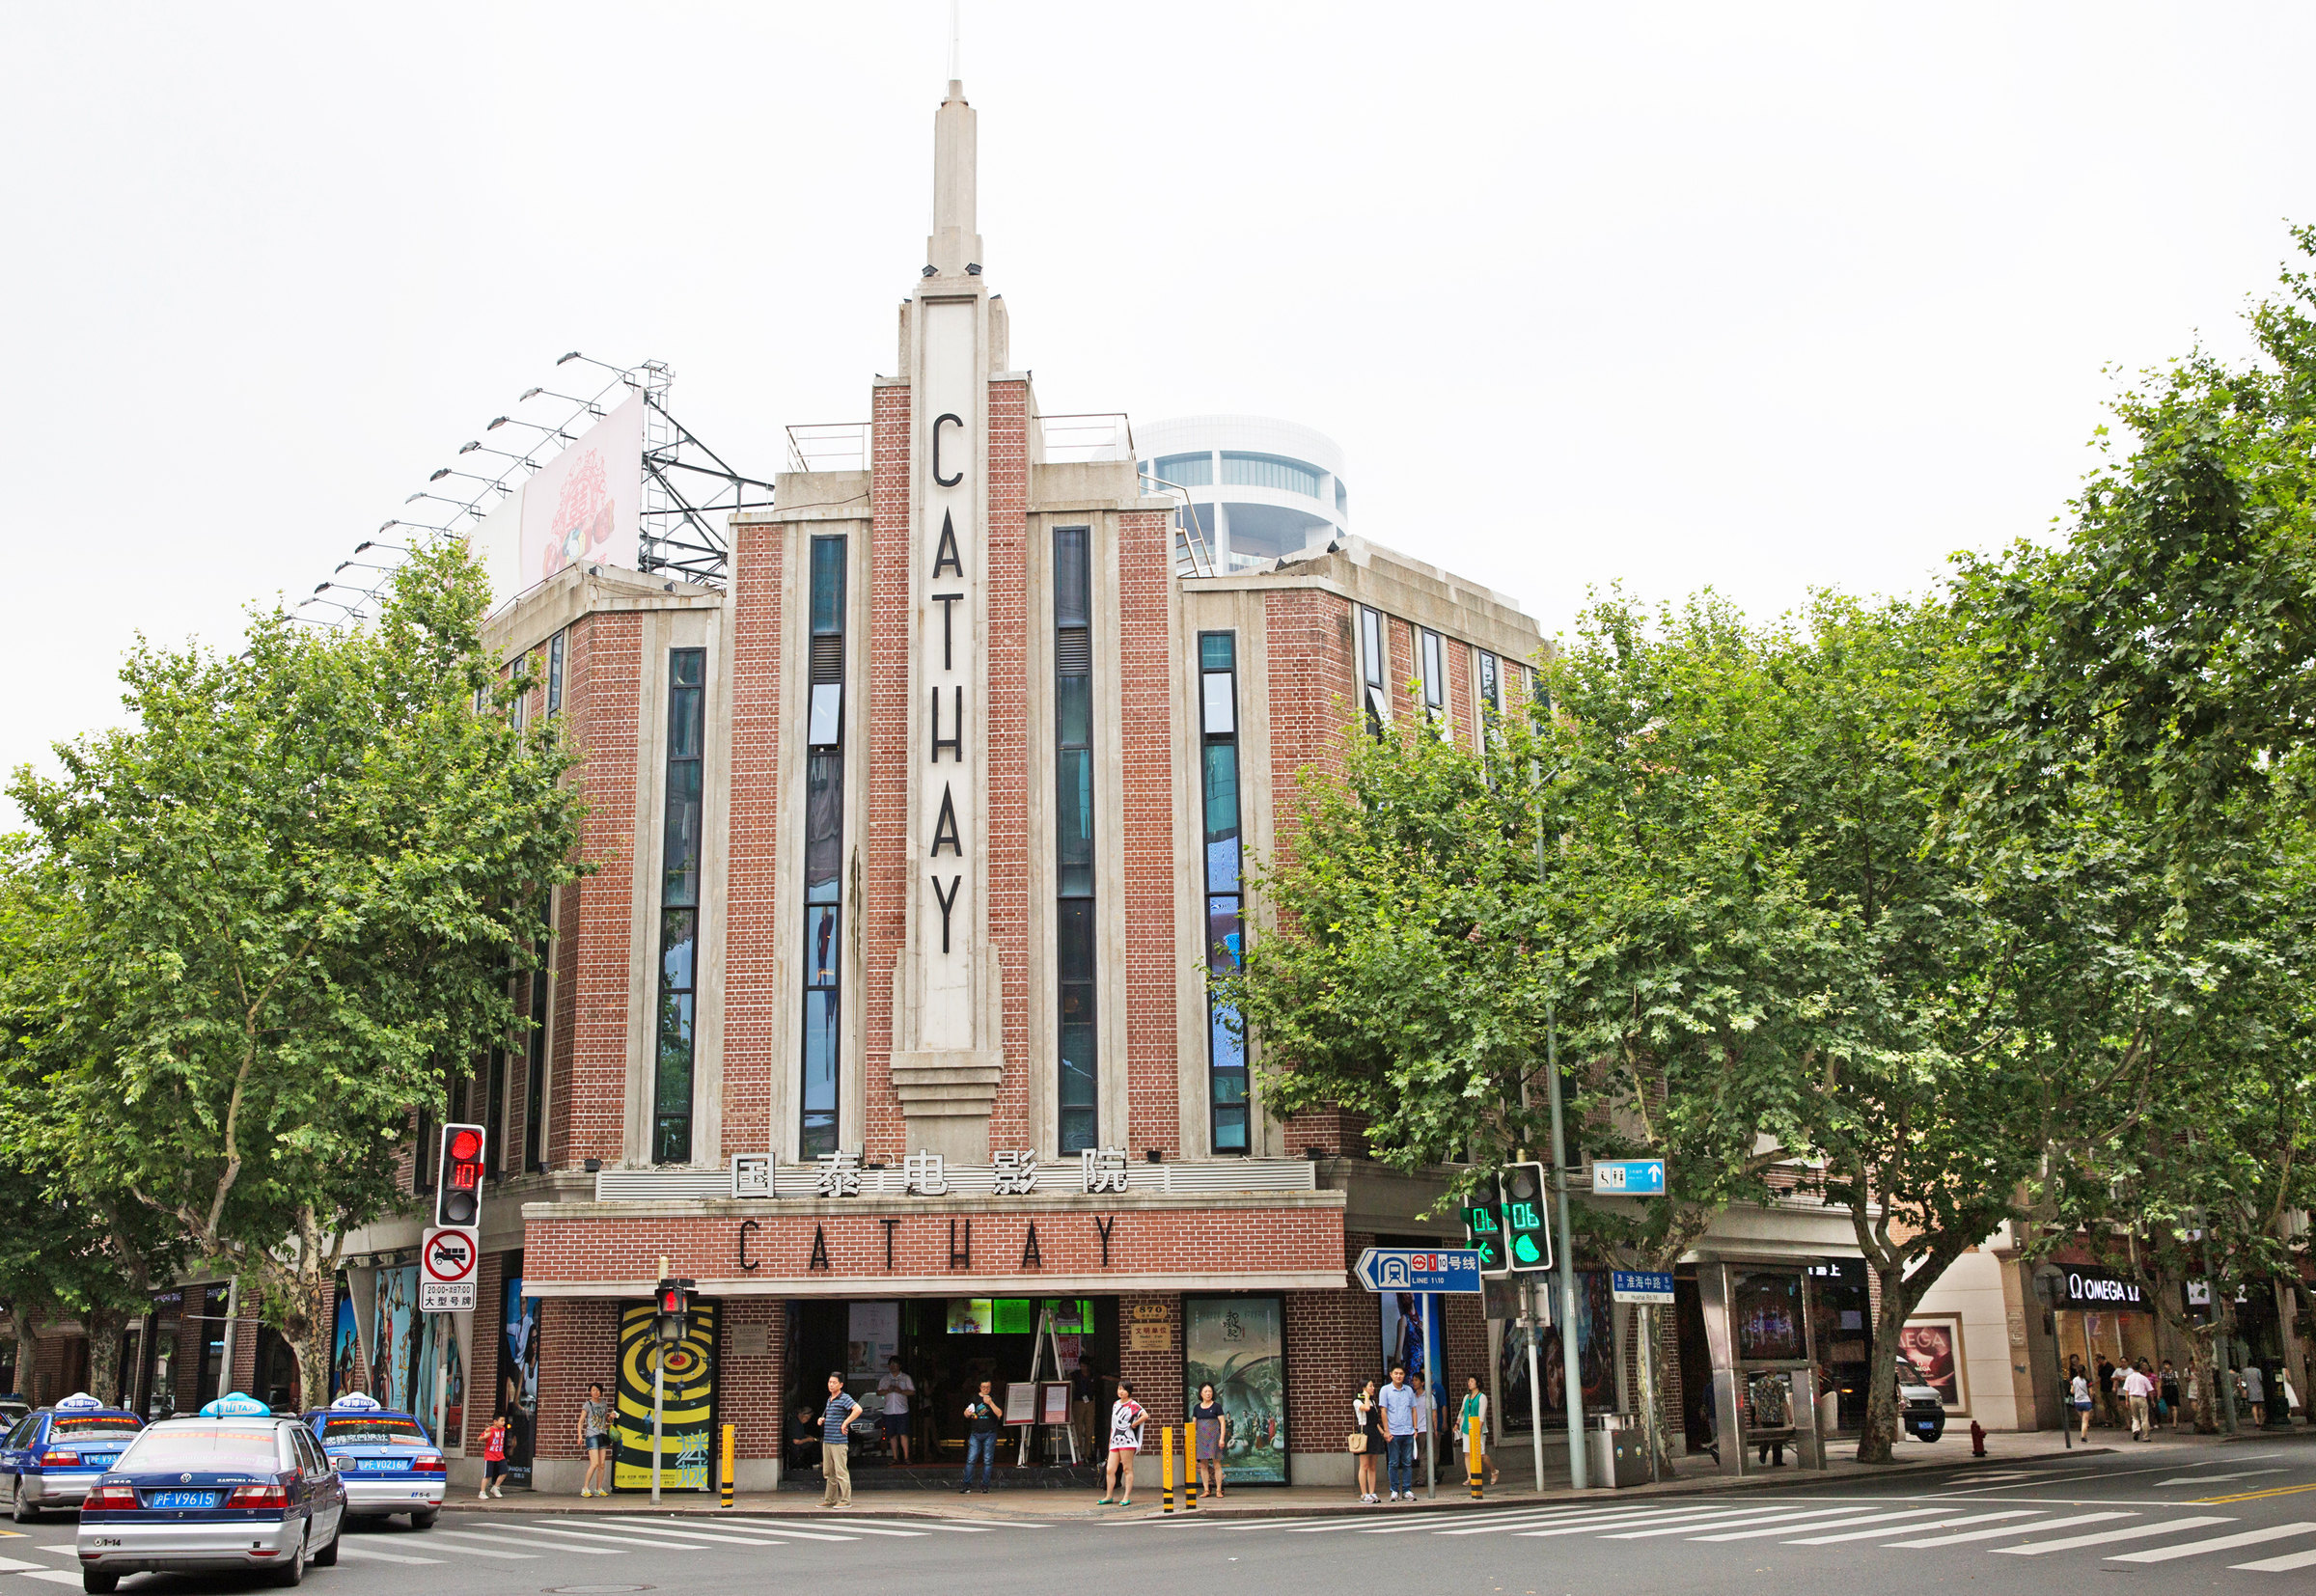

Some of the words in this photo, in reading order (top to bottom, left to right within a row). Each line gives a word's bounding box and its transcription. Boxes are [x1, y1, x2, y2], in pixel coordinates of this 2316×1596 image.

[931, 413, 964, 953] CATHAY
[455, 1164, 475, 1188] 10
[731, 1145, 1129, 1198] 国泰电影院
[1512, 1202, 1540, 1228] 06
[739, 1216, 1115, 1271] CATHAY
[1448, 1256, 1476, 1271] 号线
[1626, 1275, 1661, 1289] 淮海中路
[2084, 1279, 2126, 1301] OMEGA
[425, 1296, 472, 1307] 大型号牌
[238, 1404, 257, 1413] TAXI
